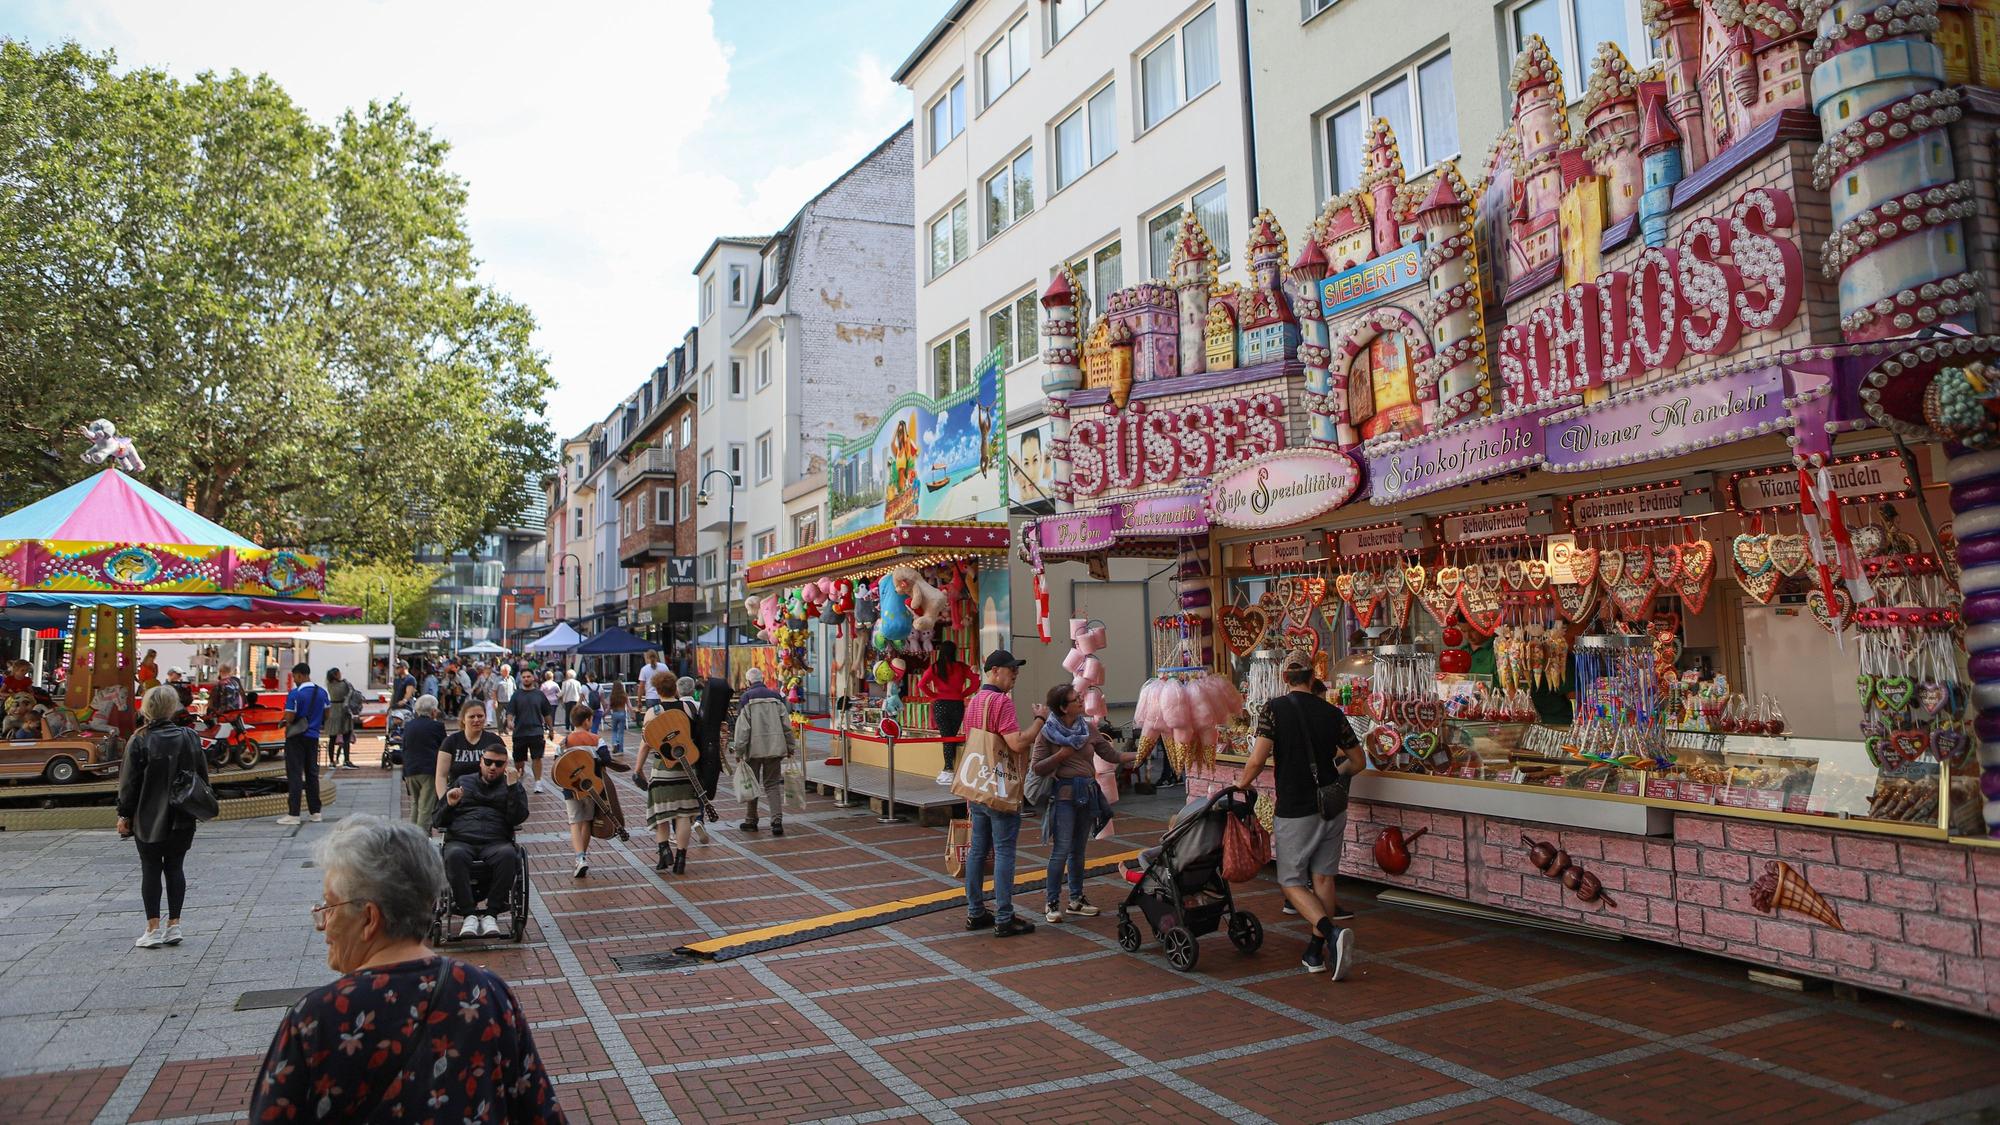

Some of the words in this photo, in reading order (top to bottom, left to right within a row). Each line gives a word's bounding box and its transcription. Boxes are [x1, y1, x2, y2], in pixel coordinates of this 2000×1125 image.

[1324, 251, 1420, 309] SIEBERT'S
[1499, 187, 1803, 411] SCHLOSS
[1560, 421, 1641, 454] Wiener
[1650, 386, 1767, 437] Mandeln
[1069, 394, 1284, 495] SÜSSES
[1384, 429, 1534, 494] Schokofrüchte
[1215, 486, 1247, 513] Süße
[1251, 467, 1346, 515] Spezialitäten
[1758, 479, 1800, 498] Wiene
[1814, 466, 1882, 489] andeln
[1120, 502, 1197, 529] Zuckerwatte
[1462, 514, 1527, 534] Schokofrüchte
[1579, 500, 1634, 523] gebrannte
[1638, 493, 1683, 513] Erdnüs
[1274, 545, 1299, 560] Popcorn
[1223, 616, 1241, 627] Ich
[1229, 626, 1249, 637] liebe
[960, 752, 1008, 798] C&A
